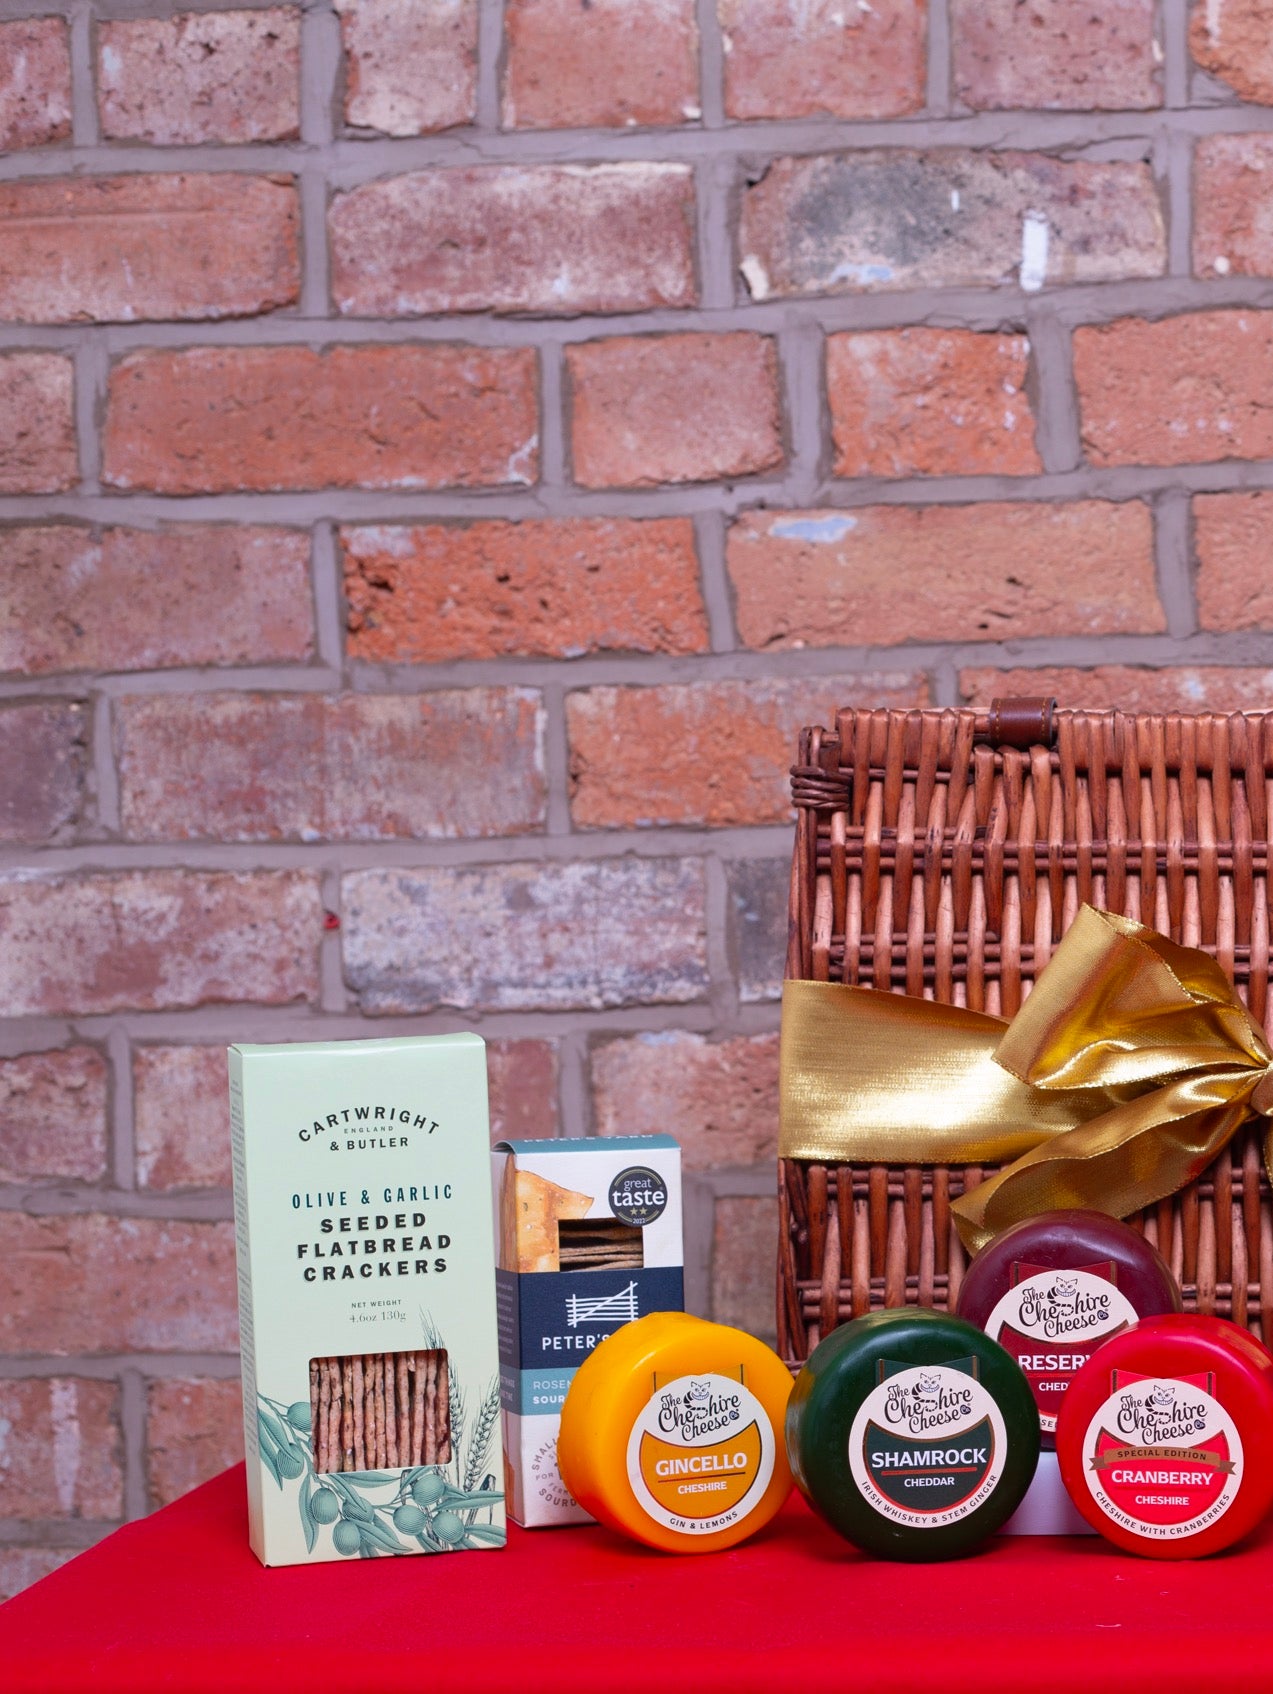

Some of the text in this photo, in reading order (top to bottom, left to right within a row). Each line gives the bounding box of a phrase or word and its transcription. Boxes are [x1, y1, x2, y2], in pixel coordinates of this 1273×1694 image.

[298, 1106, 440, 1142] CARTWRIGHT
[343, 1126, 394, 1134] ENGLAND
[329, 1136, 409, 1152] & BUTLER
[624, 1178, 652, 1192] great
[292, 1184, 453, 1209] OLIVE & GARLIC
[612, 1190, 664, 1206] taste
[320, 1212, 426, 1234] SEEDED
[297, 1234, 452, 1259] FLATBREAD
[303, 1258, 448, 1282] CRACKERS
[1022, 1286, 1045, 1304] The
[382, 1310, 406, 1322] 130g
[1044, 1313, 1098, 1338] Cheese
[1018, 1354, 1090, 1370] RESER
[661, 1393, 682, 1408] The
[888, 1384, 910, 1400] The
[1120, 1394, 1143, 1412] The
[682, 1414, 731, 1442] Cheese
[908, 1409, 962, 1434] Cheese
[1142, 1422, 1195, 1446] Cheese
[655, 1452, 748, 1476] GINCELLO
[872, 1448, 987, 1468] SHAMROCK
[1117, 1450, 1206, 1460] SPECIAL EDITION
[904, 1476, 955, 1488] CHEDDAR
[1111, 1470, 1214, 1486] CRANBERRY
[678, 1481, 728, 1495] CHESHIRE
[862, 1481, 882, 1506] IRISH
[884, 1504, 928, 1524] WHISKEY
[942, 1506, 968, 1522] STEM
[970, 1474, 997, 1508] GINGER
[1135, 1495, 1190, 1506] CHESHIRE
[670, 1517, 686, 1528] GIN
[700, 1511, 738, 1530] LEMONS
[1096, 1491, 1230, 1536] CHESHIRE WITH CRANBERRIES
